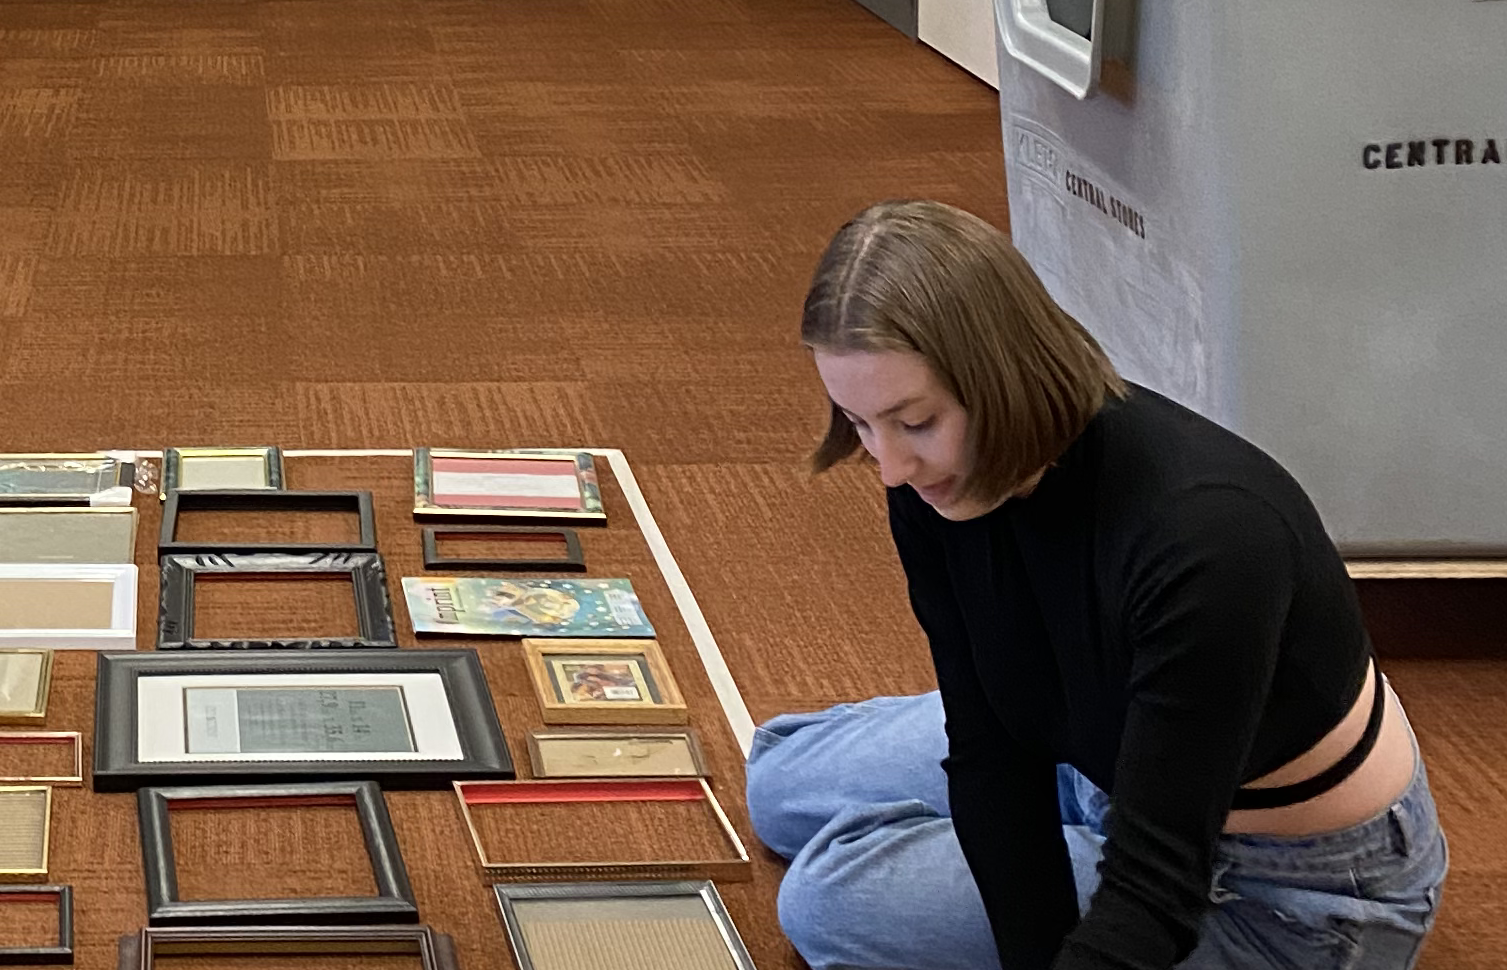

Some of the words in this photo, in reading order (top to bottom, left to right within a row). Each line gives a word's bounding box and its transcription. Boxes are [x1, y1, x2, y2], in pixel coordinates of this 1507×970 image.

[1363, 138, 1507, 170] CENTRA
[1065, 169, 1108, 215] CENTRAL
[1109, 195, 1146, 240] STORES
